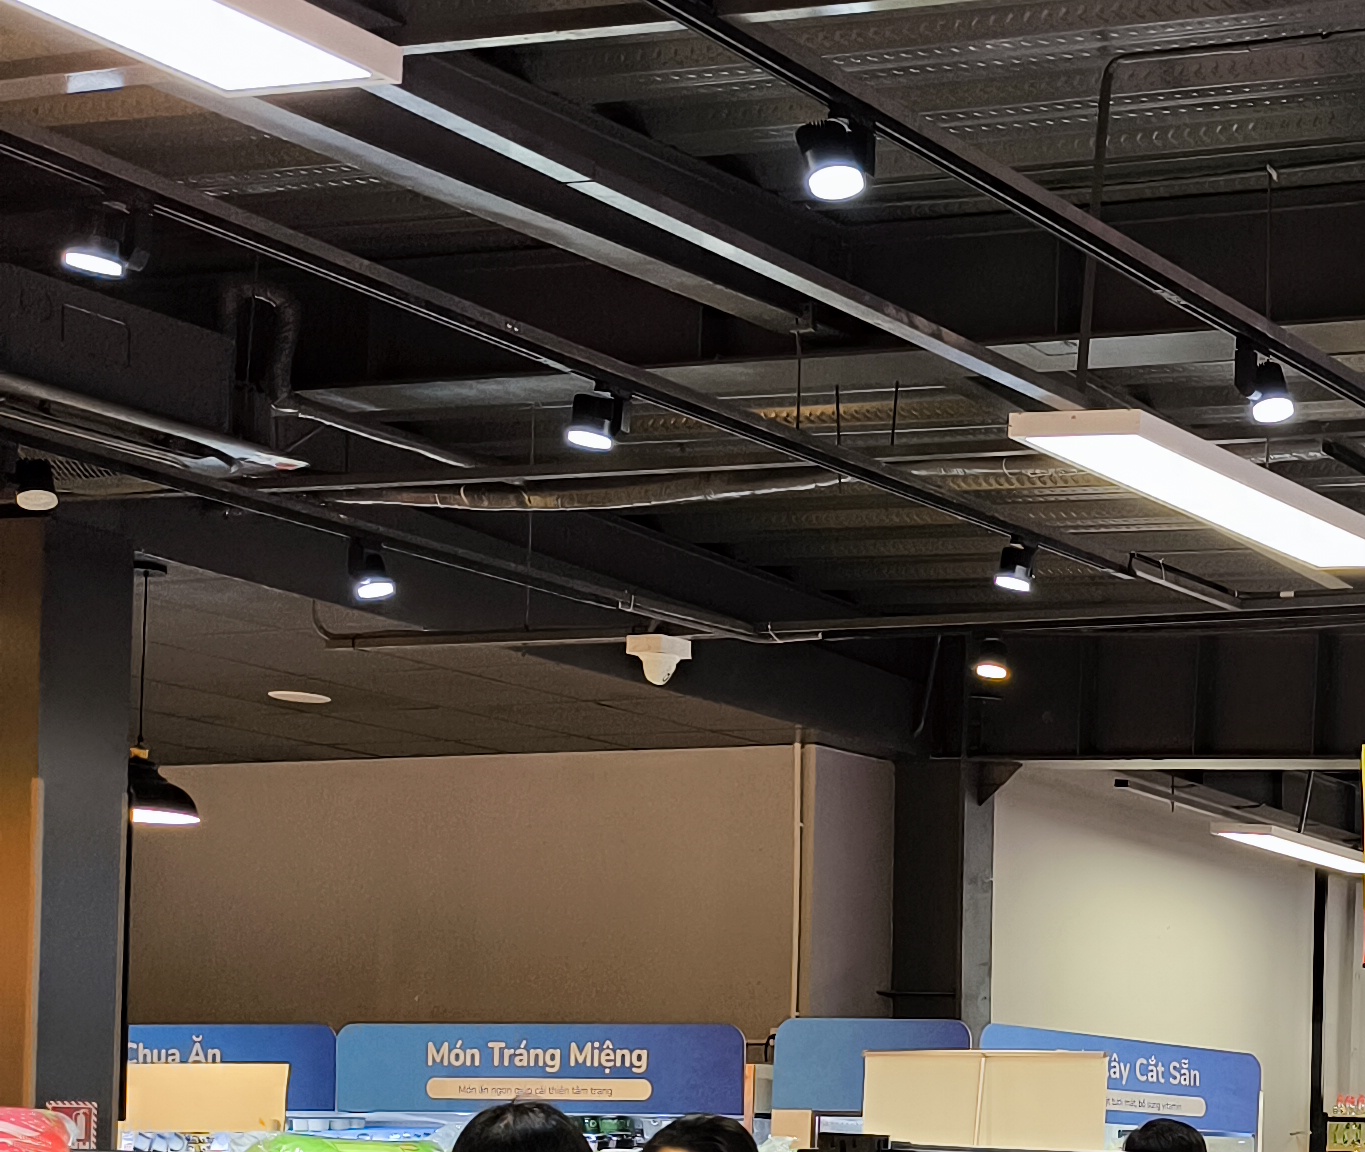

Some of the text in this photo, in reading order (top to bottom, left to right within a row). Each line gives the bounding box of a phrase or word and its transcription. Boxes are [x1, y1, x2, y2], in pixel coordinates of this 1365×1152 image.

[127, 1034, 221, 1063] Chua Ăn
[427, 1040, 648, 1074] Món Tráng Miệng
[1107, 1053, 1200, 1087] ây Cắt Sẵn
